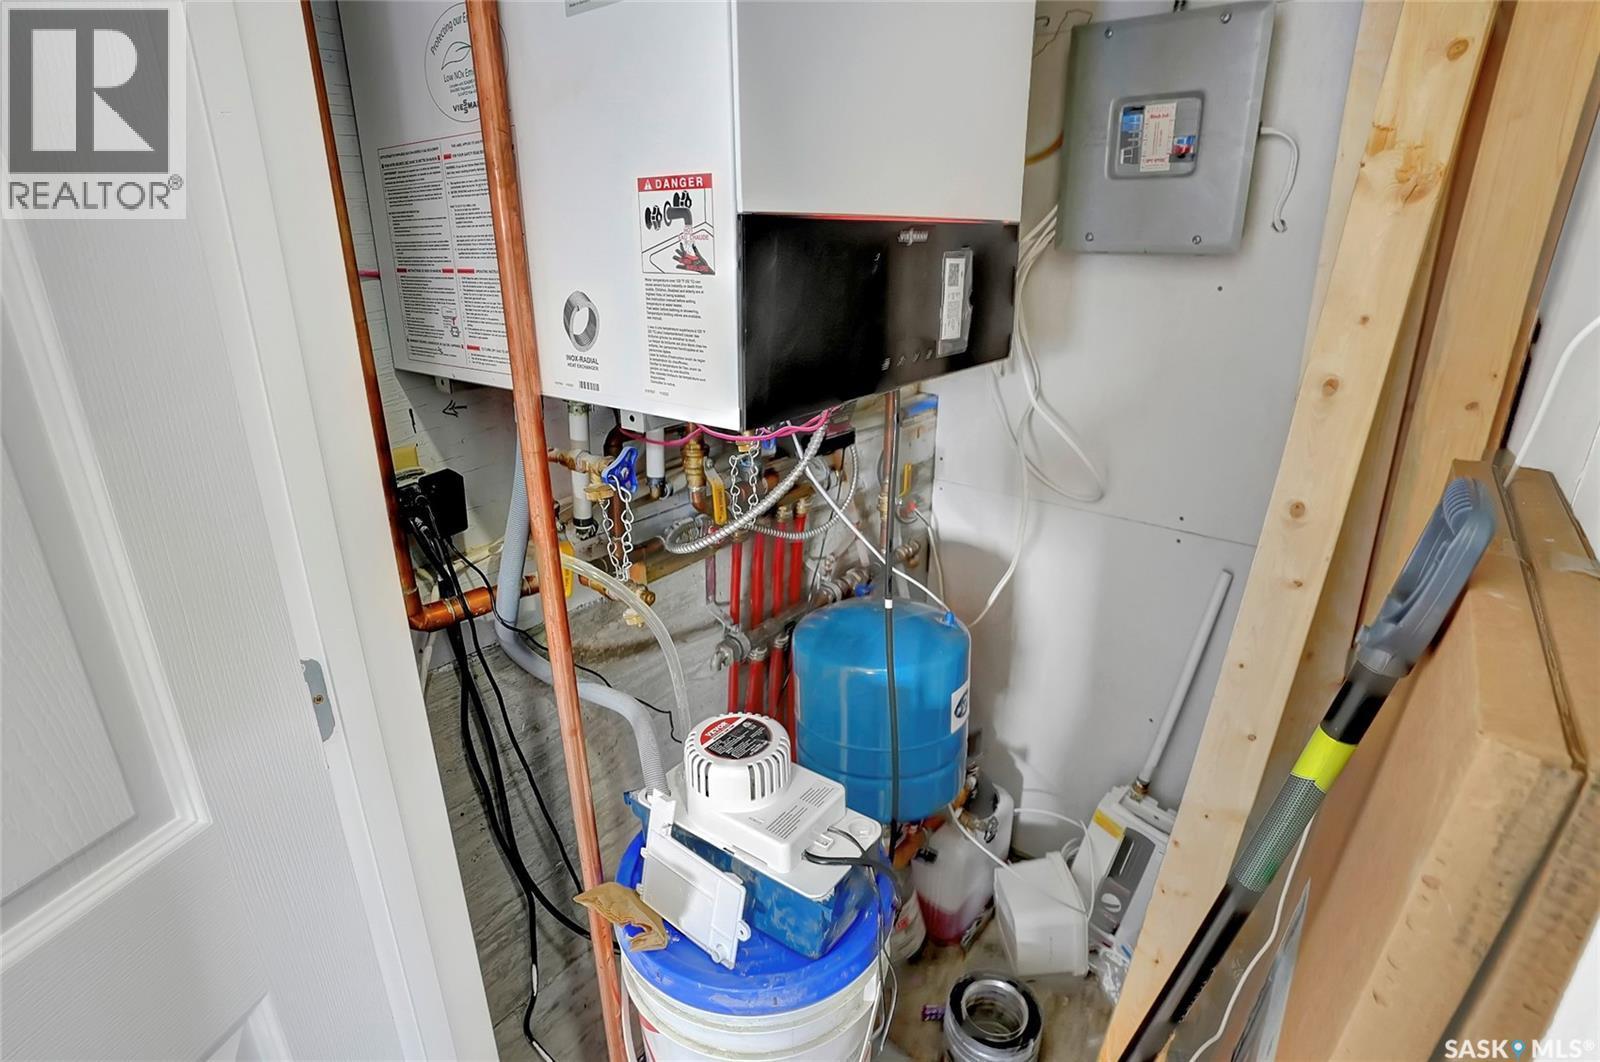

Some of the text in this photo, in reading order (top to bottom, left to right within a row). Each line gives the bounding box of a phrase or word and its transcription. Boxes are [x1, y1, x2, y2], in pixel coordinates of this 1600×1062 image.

[430, 20, 454, 56] Protecting
[443, 74, 454, 83] Low
[452, 99, 478, 114] VIESSMA
[655, 177, 704, 189] DANGER
[566, 354, 599, 366] INOX-RADIAL
[704, 720, 729, 738] VEVOR
